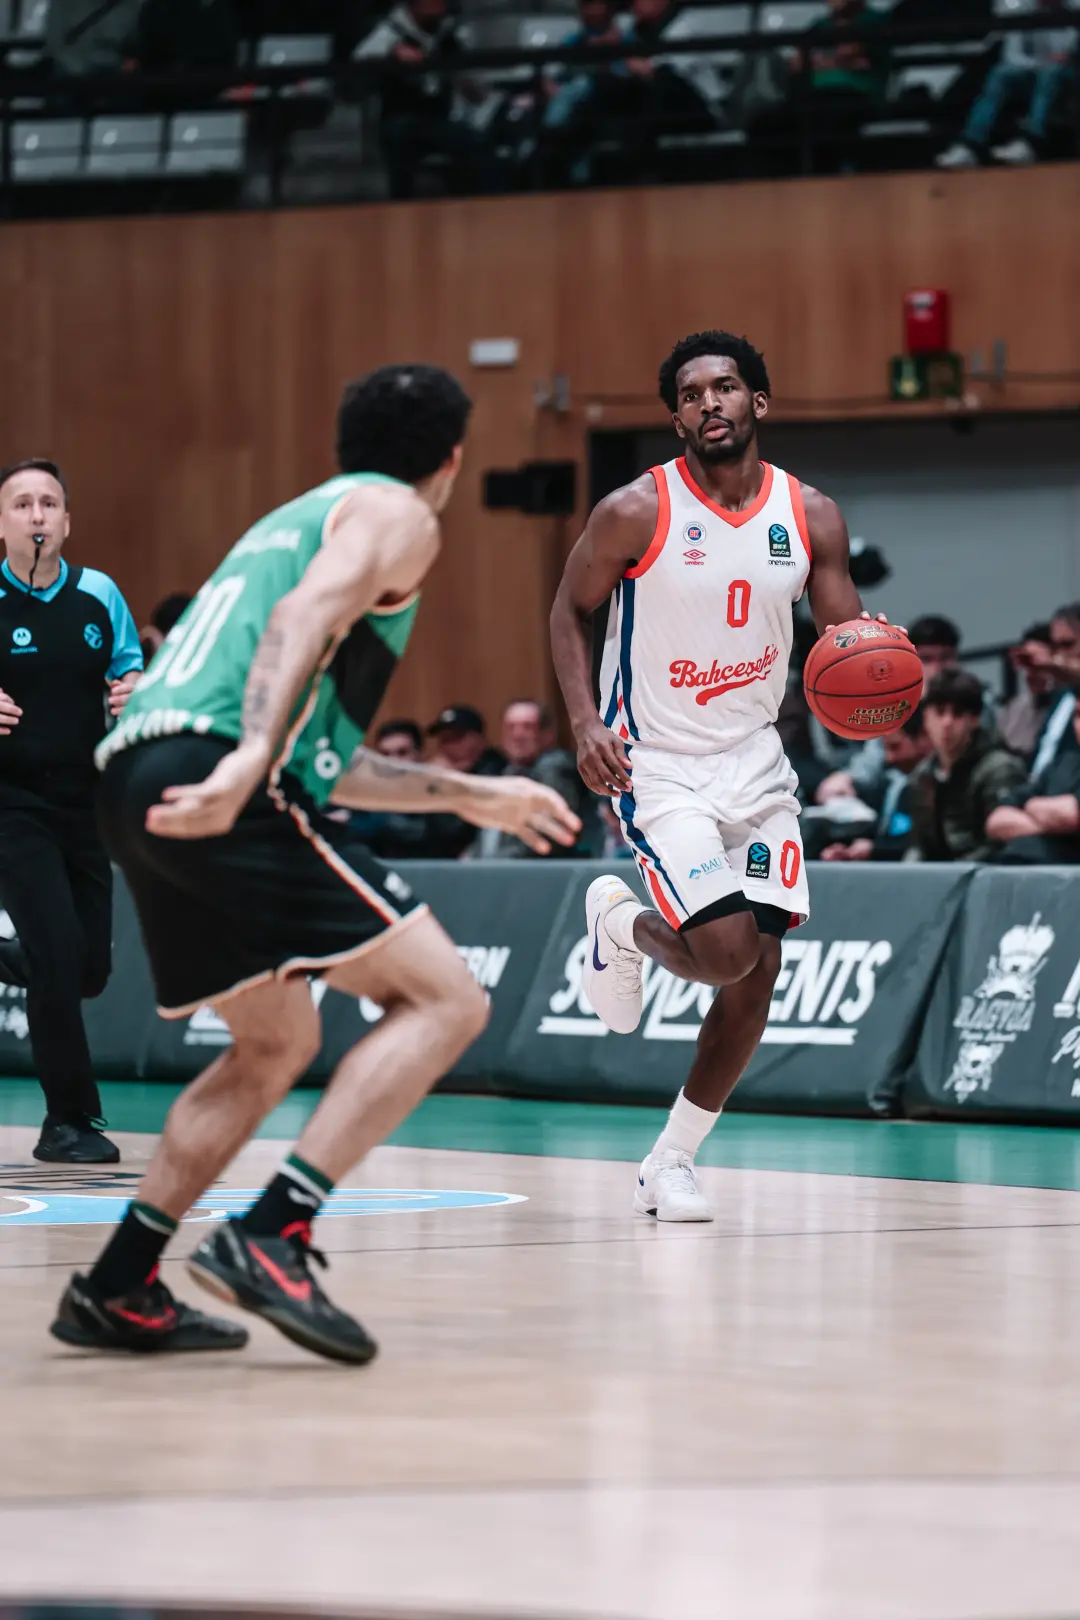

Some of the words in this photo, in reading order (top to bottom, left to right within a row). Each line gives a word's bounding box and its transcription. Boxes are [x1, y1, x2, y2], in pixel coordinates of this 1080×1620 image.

[726, 579, 751, 628] 0
[701, 857, 722, 872] BAU
[747, 868, 768, 878] EuroCup
[780, 839, 801, 890] 0
